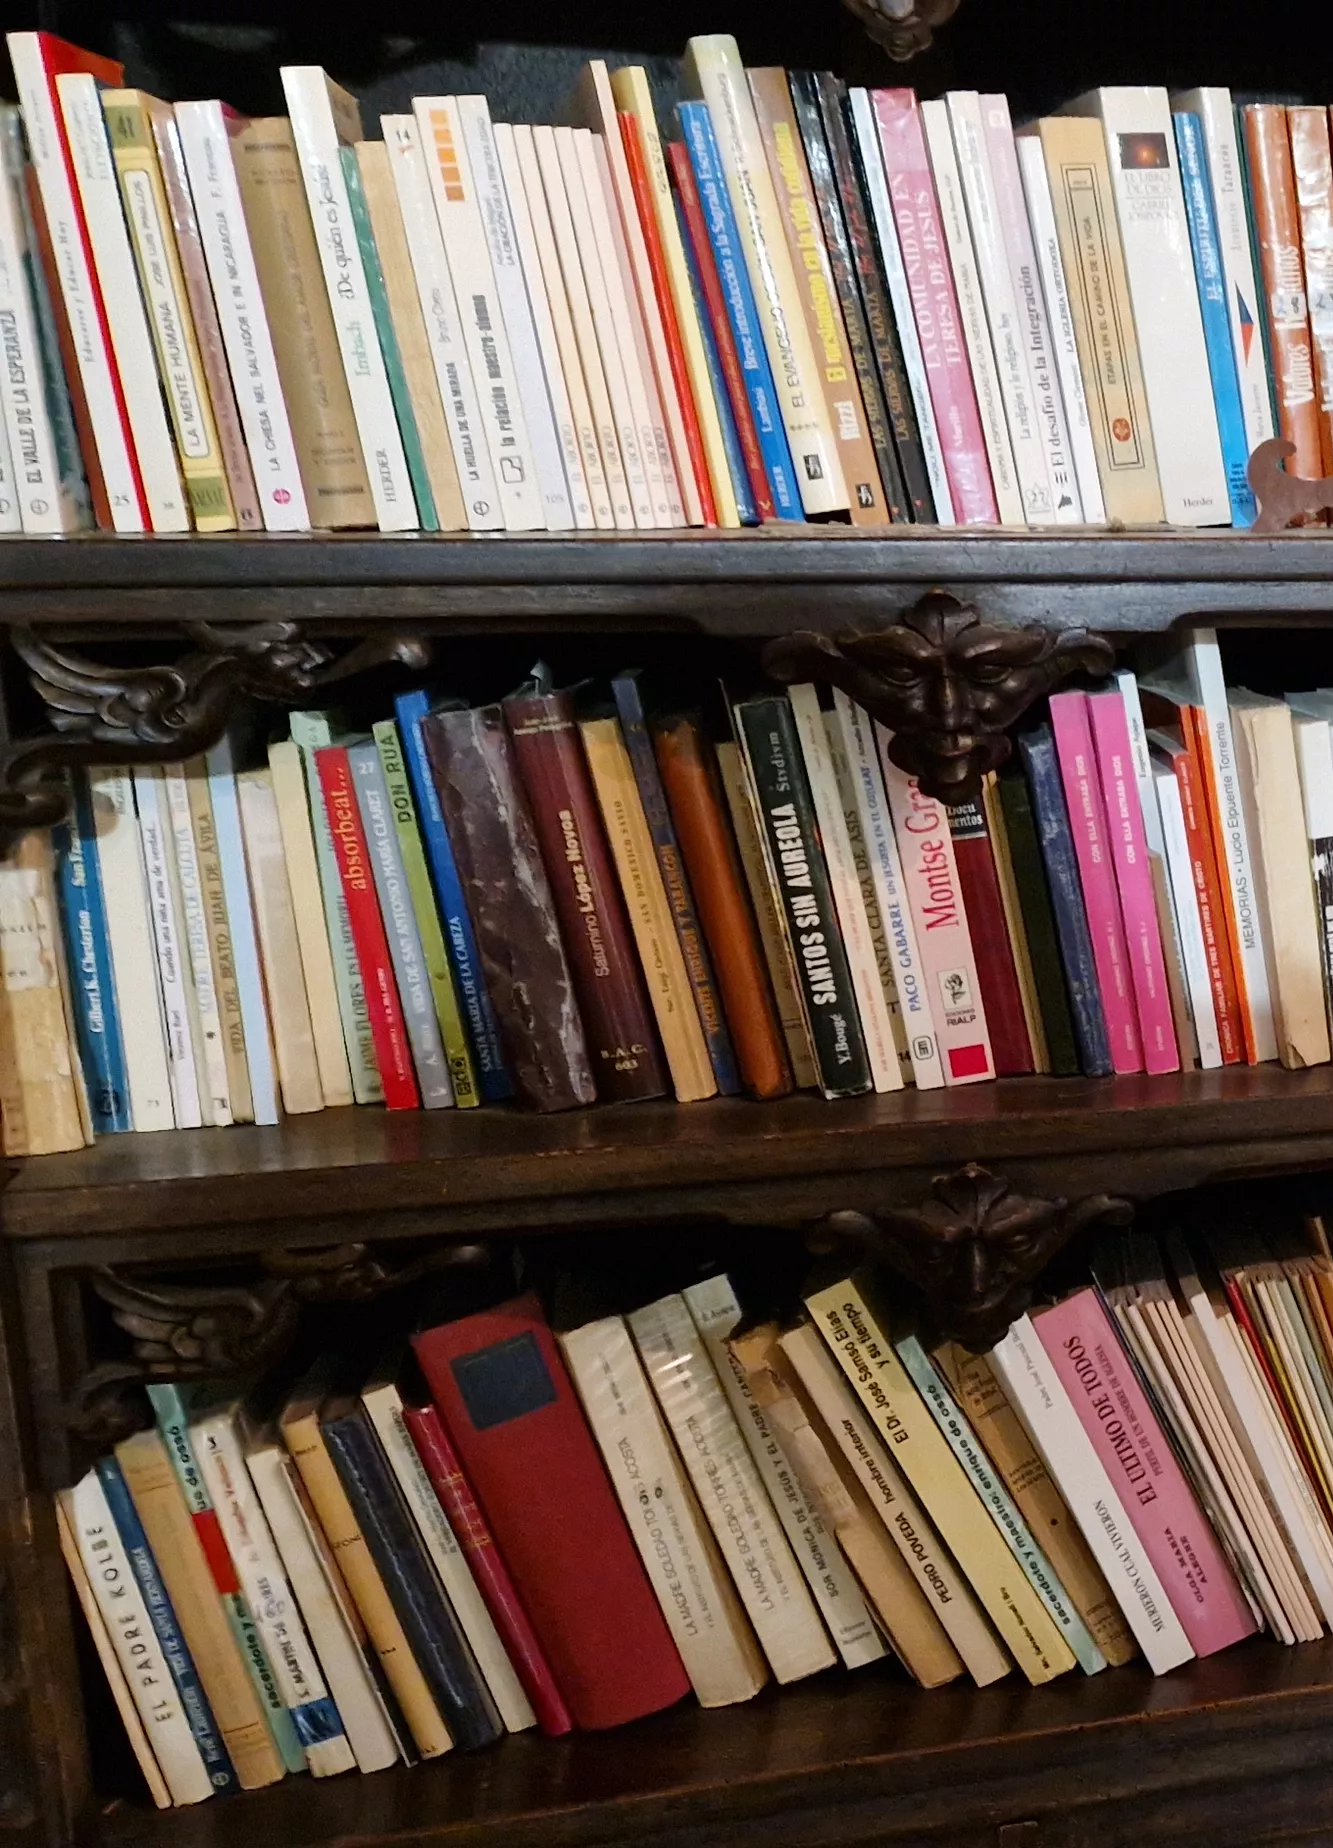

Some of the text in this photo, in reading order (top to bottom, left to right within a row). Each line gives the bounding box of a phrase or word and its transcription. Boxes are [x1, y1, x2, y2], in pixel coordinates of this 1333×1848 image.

[690, 119, 712, 179] Escritura
[324, 210, 337, 224] es
[327, 228, 352, 268] quién
[705, 183, 727, 234] Sagrada
[717, 235, 731, 249] la
[337, 273, 356, 300] ¿De
[720, 260, 752, 337] introducción
[892, 173, 941, 369] LA COMUNIDAD EN
[916, 190, 962, 366] TERESA DE JESUS
[0, 309, 43, 484] EL VALLE DE LA ESPERANZA
[158, 301, 201, 447] LA MENTE HUMANA
[347, 320, 372, 376] Imbach
[471, 295, 515, 446] la relación maestro-alumno
[740, 340, 758, 370] Breve
[1018, 266, 1065, 467] El desafío de la Integración
[1282, 343, 1314, 407] Valores
[376, 449, 397, 502] HERDER
[380, 734, 412, 823] DON RUA
[915, 838, 960, 928] Montse
[1213, 722, 1255, 949] MEMORIAS Lucio Elpuente Torrente
[558, 810, 610, 978] Saturnino López Novoa
[771, 804, 837, 1006] SANTOS SIN AUREOLA
[77, 910, 104, 1033] Gilbert K. Chesterton
[888, 901, 920, 1012] PACO GABARRE
[825, 1310, 910, 1444] El Dr. José Samsó Elías
[842, 1303, 890, 1369] y su tiempo
[1063, 1335, 1158, 1505] EL ULTIMO DE TODOS
[840, 1418, 953, 1604] PEDRO POVEDA hombre interior
[1181, 1535, 1208, 1585] ALEGRE
[1093, 1498, 1167, 1633] MURIERON CUAL VIVIERON
[1162, 1527, 1206, 1604] OLGA MARIA
[86, 1525, 173, 1722] EL PADRE KOLBE
